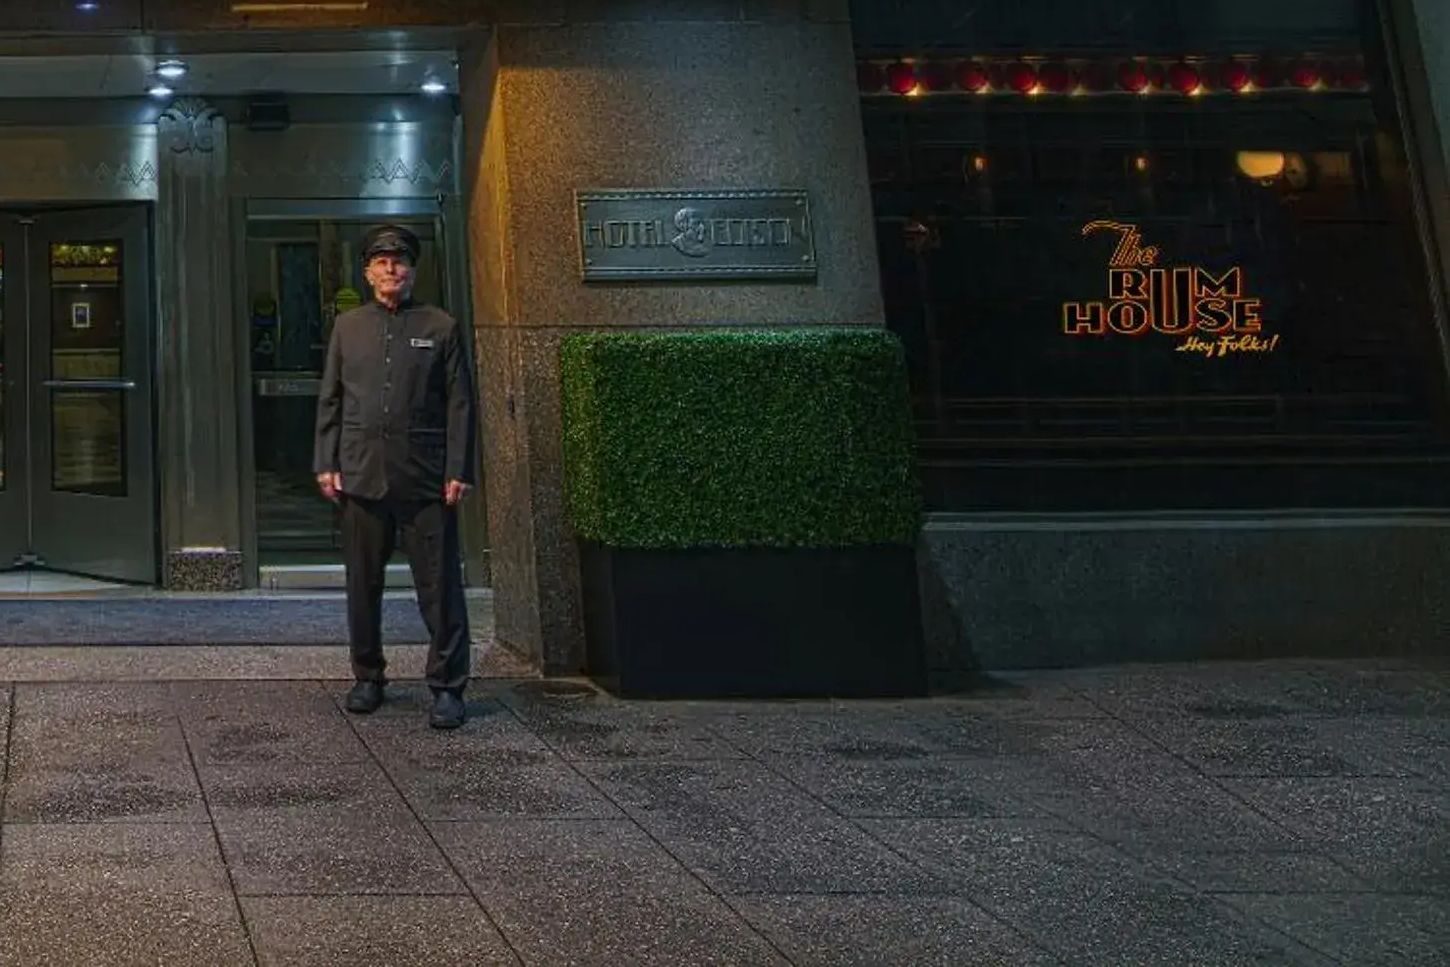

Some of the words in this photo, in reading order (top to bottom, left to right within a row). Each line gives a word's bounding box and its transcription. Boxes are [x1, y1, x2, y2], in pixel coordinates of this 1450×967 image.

[584, 220, 671, 248] HOTEL
[1081, 219, 1162, 267] The
[1063, 267, 1263, 334] HOUSE
[1108, 266, 1242, 334] RUM
[1174, 336, 1214, 358] Hey
[1214, 335, 1280, 358] Folks!
